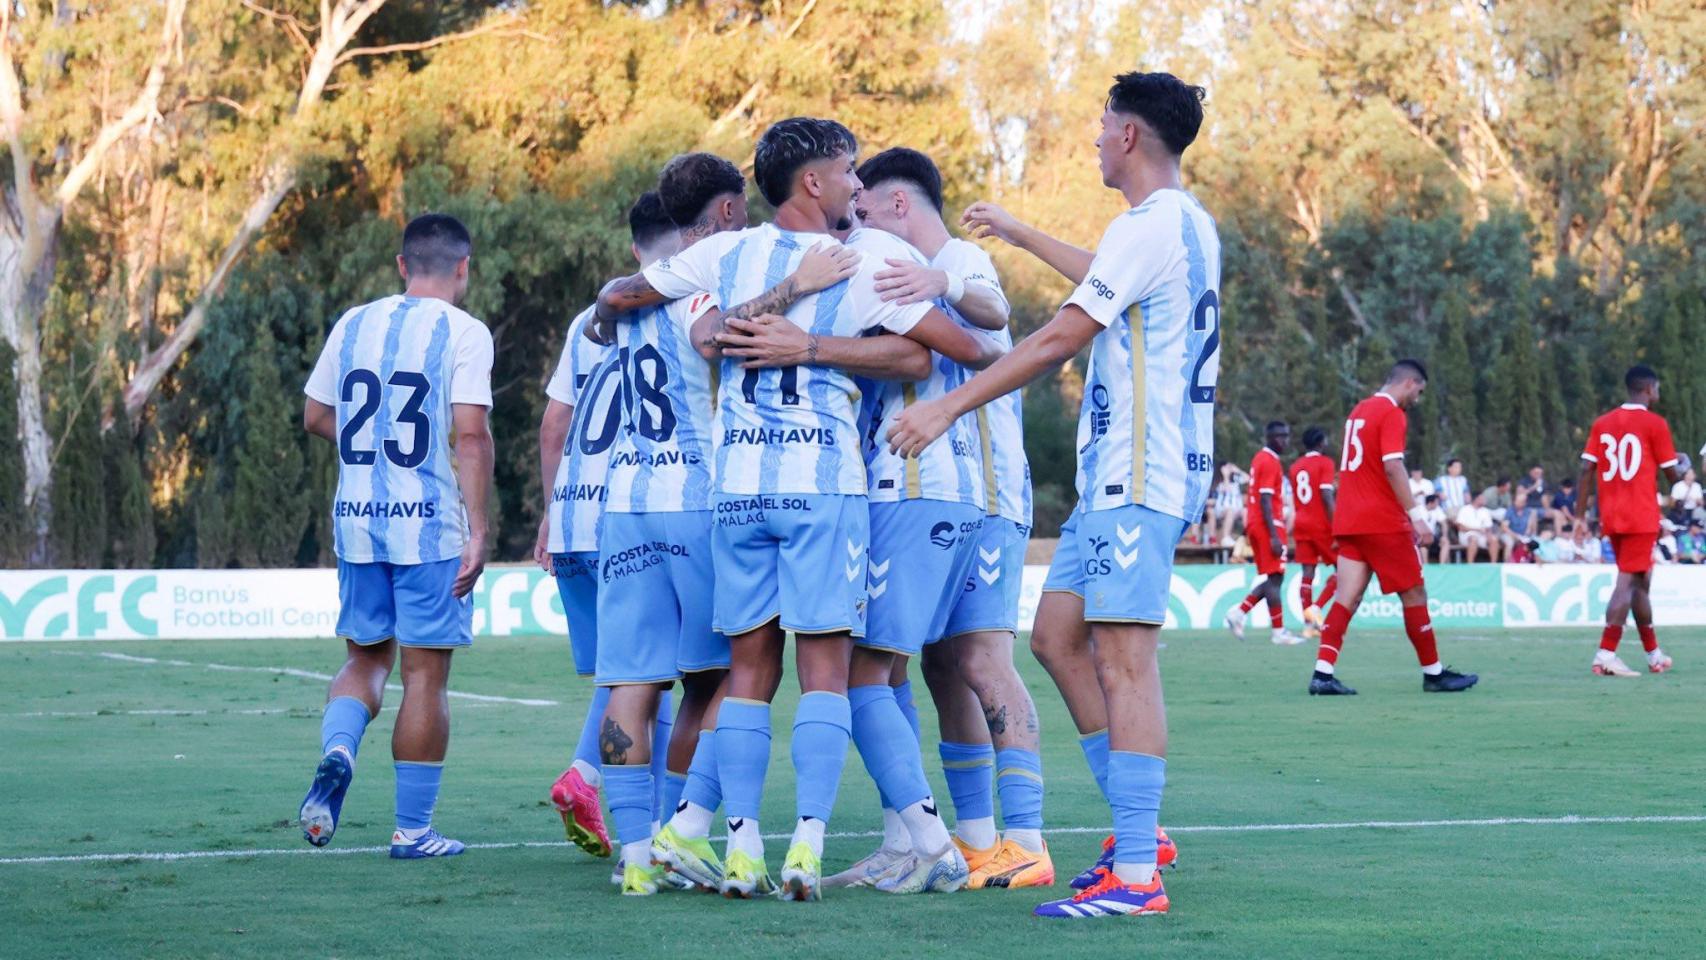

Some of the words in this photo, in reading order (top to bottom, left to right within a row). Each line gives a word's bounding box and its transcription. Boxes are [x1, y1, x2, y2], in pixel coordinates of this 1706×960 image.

[339, 369, 432, 468] 23
[723, 428, 834, 446] BENAHAVIS
[1340, 419, 1366, 471] 15
[1600, 433, 1642, 481] 30
[1296, 470, 1312, 504] 8
[335, 501, 435, 518] BENAHAVIS
[717, 499, 760, 513] COSTA
[782, 498, 811, 511] SOL
[610, 543, 652, 566] COSTA
[174, 586, 249, 603] Banús
[174, 608, 273, 626] Football
